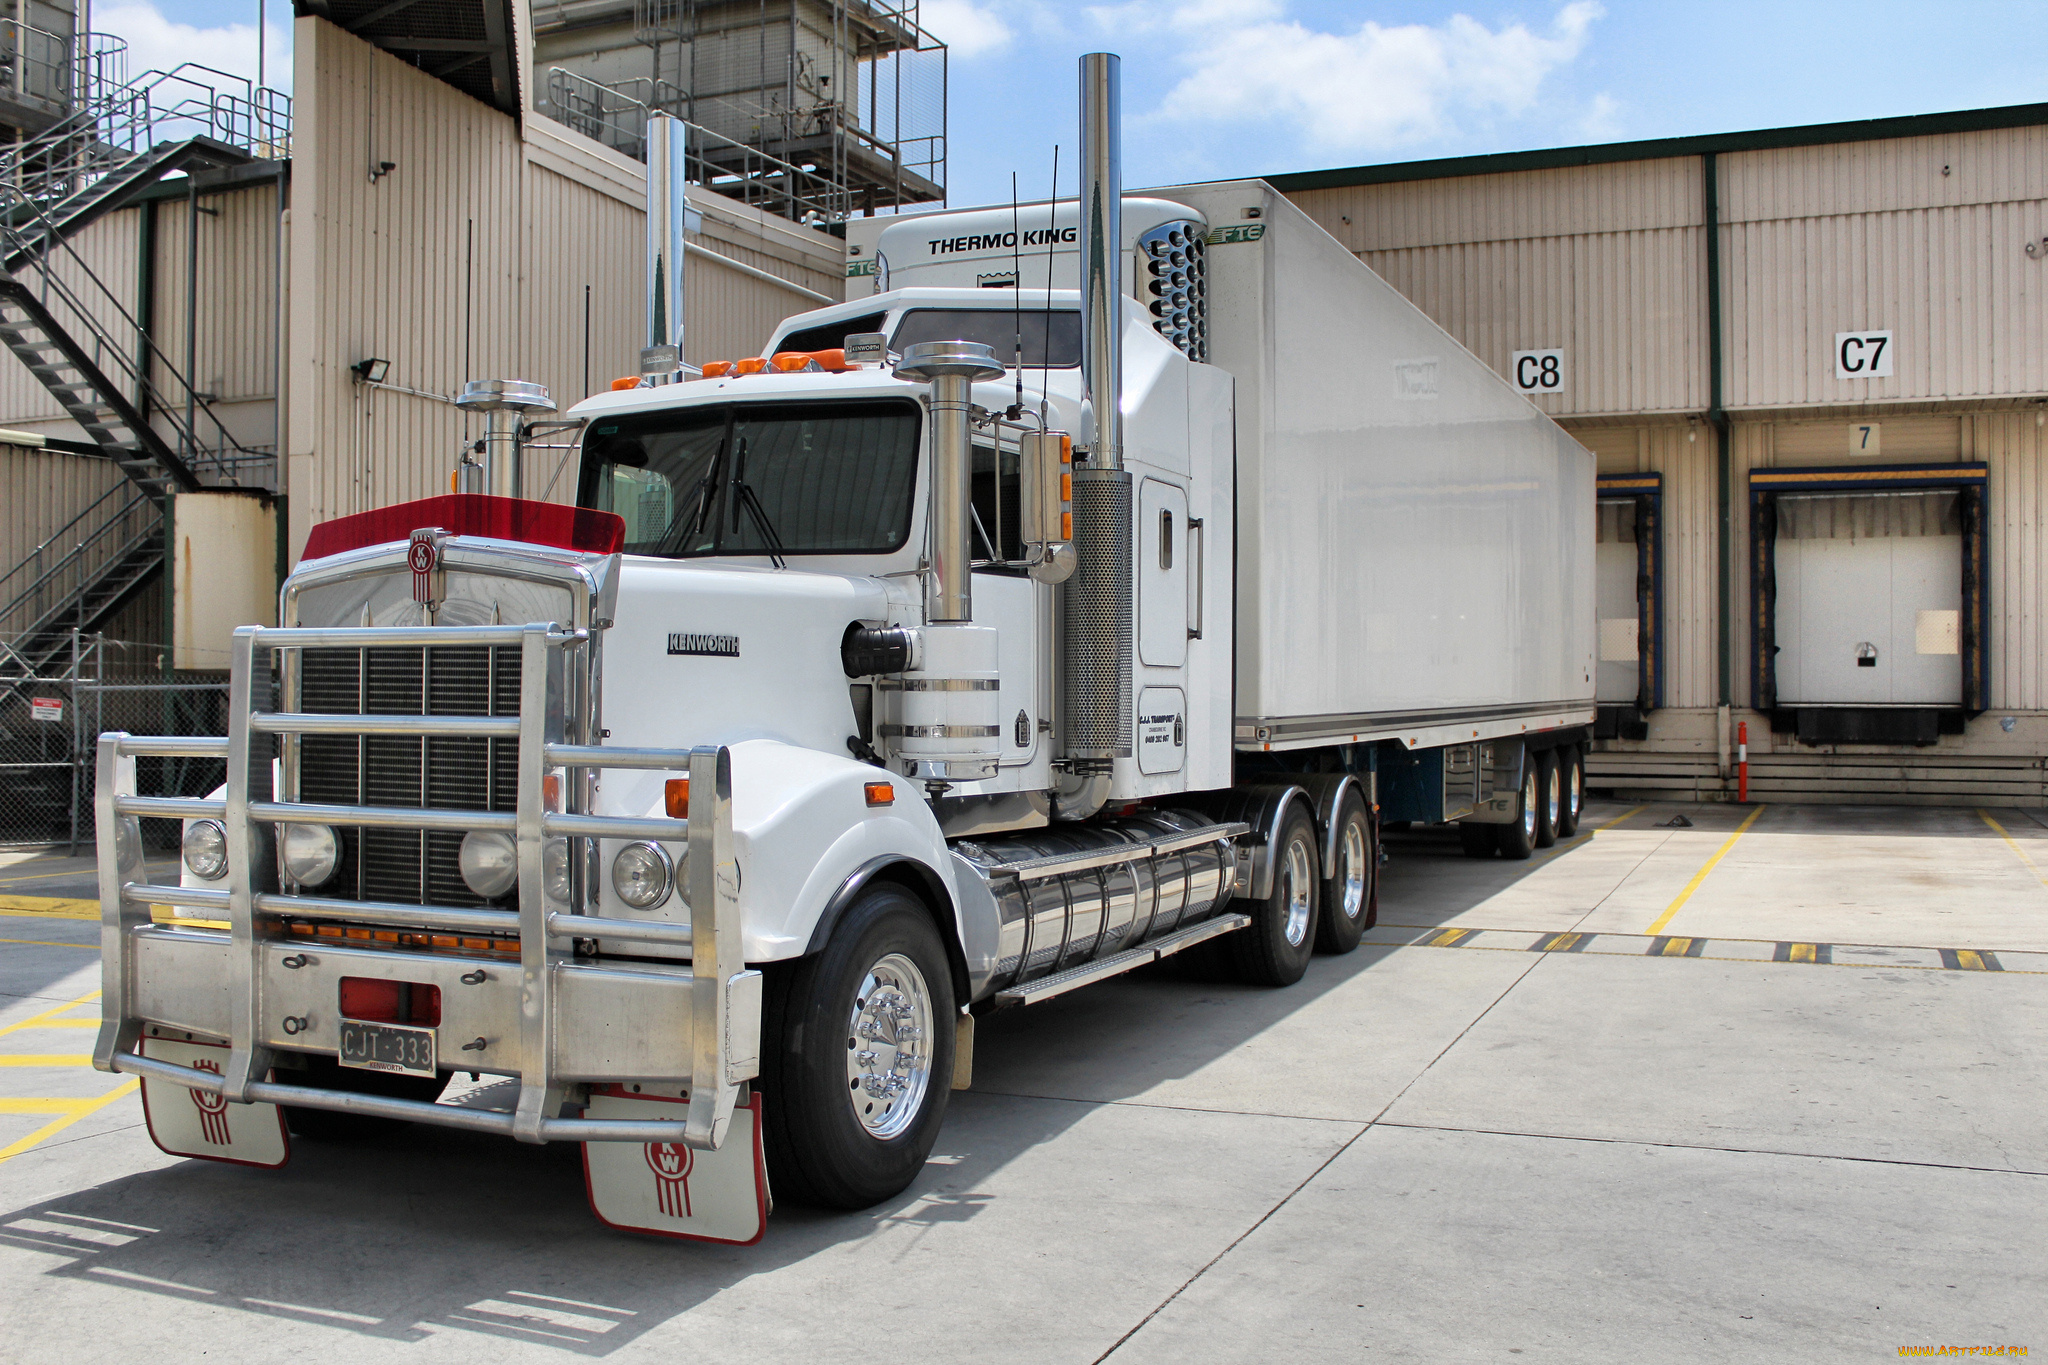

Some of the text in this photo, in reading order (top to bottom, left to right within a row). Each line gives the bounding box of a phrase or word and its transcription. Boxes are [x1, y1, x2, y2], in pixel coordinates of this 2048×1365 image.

[928, 227, 1077, 255] THERMO KING
[1221, 224, 1263, 242] FTE
[1841, 337, 1888, 373] C7
[1517, 355, 1560, 389] C8
[1859, 426, 1871, 449] 7
[668, 633, 740, 654] KENWORTH
[369, 1061, 404, 1072] KENWORTH
